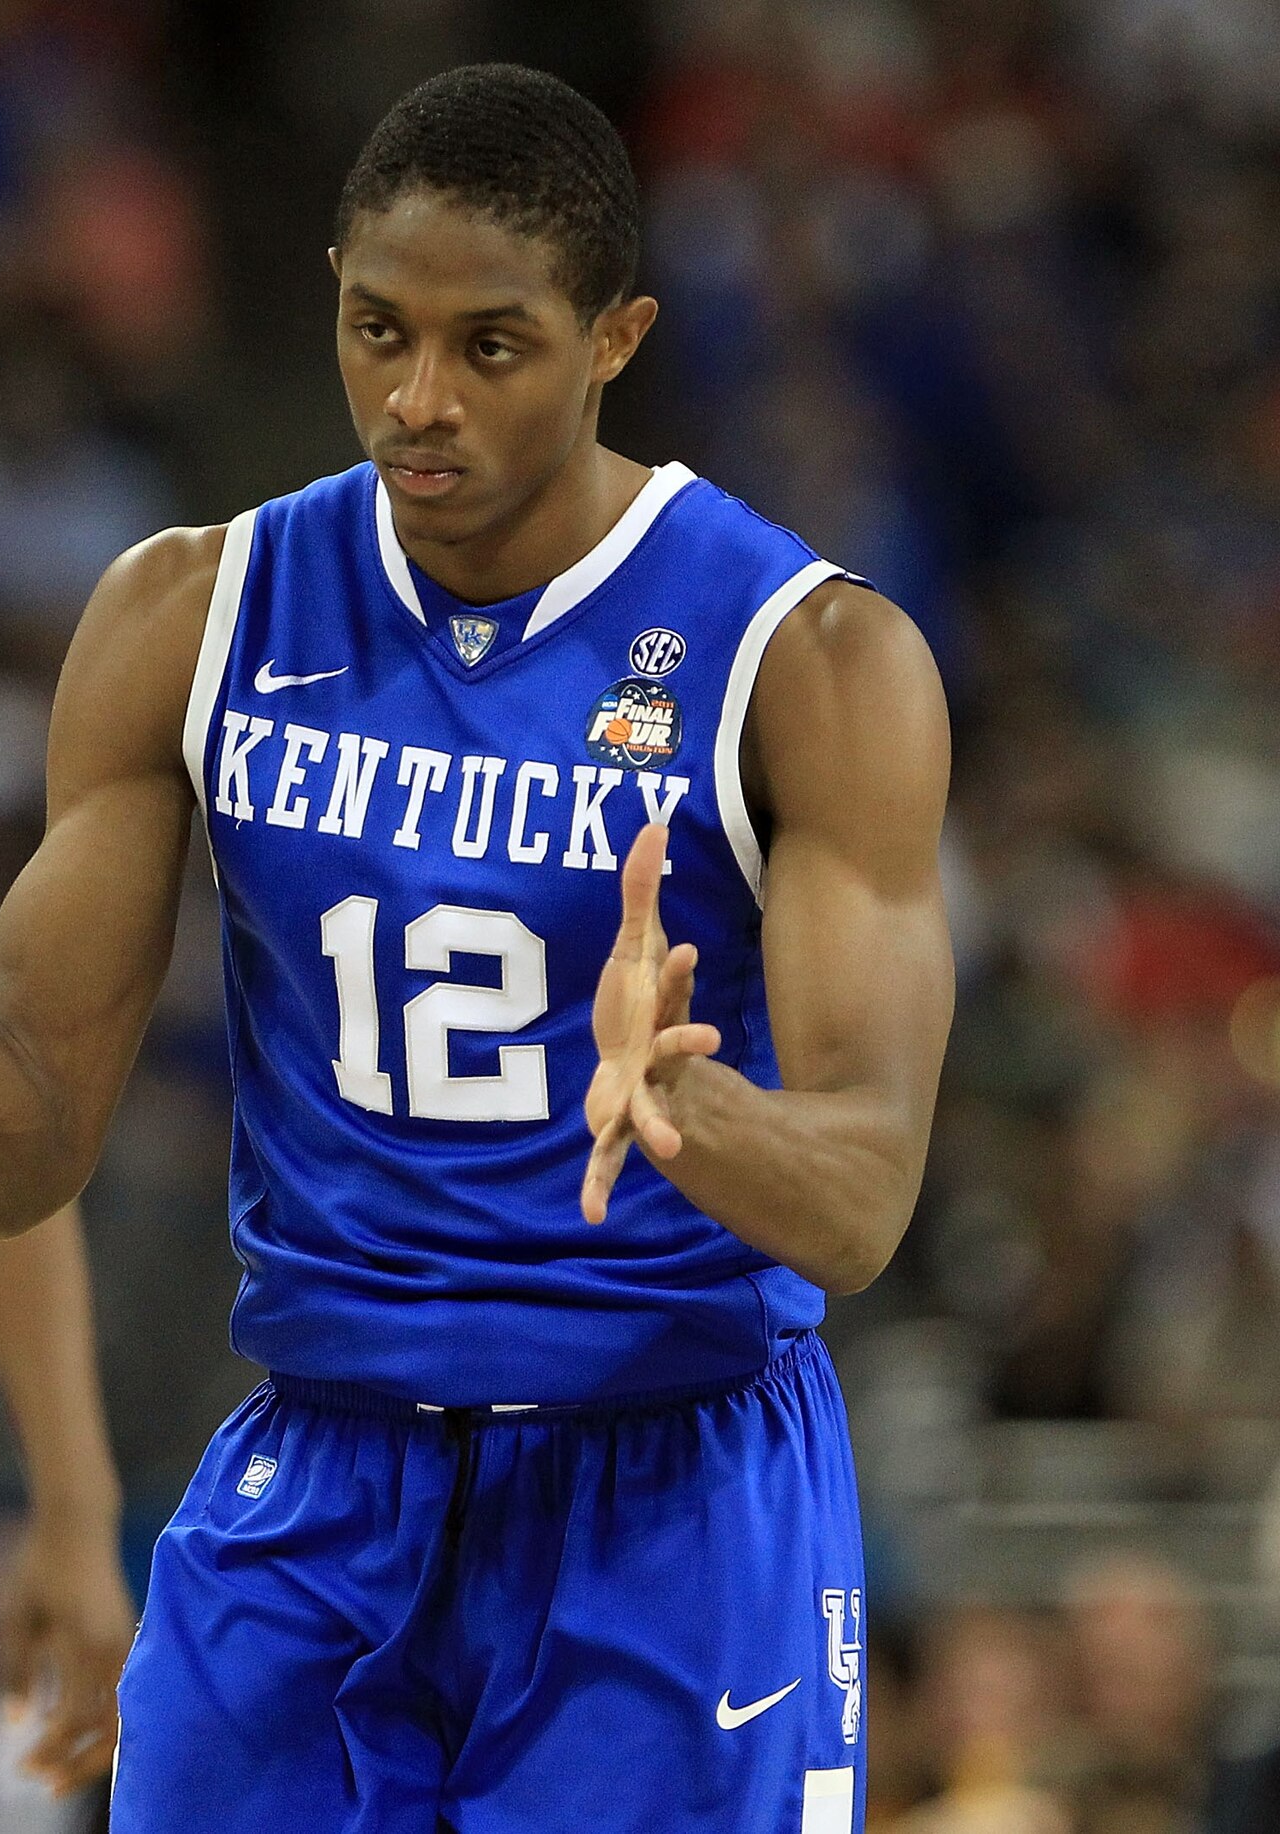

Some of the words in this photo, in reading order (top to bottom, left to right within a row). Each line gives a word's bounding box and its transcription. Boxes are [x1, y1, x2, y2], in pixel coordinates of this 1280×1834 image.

[634, 632, 681, 673] SEC
[615, 697, 674, 725] FINAL
[215, 709, 691, 875] KENTUCKY
[320, 894, 551, 1122] 12
